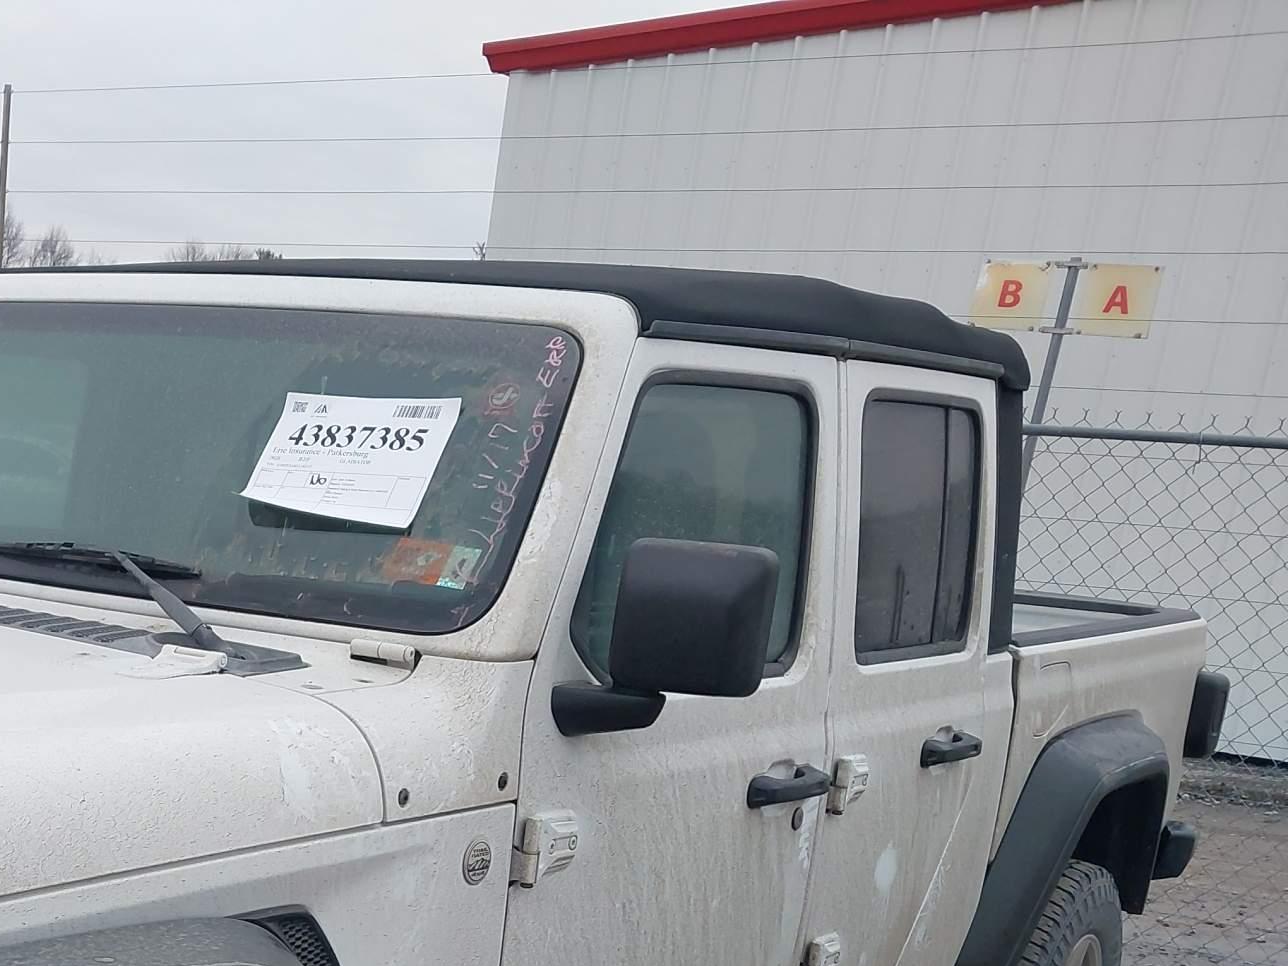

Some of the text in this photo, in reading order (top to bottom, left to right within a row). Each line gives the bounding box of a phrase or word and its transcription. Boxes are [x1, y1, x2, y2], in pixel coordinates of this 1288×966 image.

[997, 279, 1023, 308] B
[1102, 285, 1129, 315] A
[288, 423, 430, 451] 43837385
